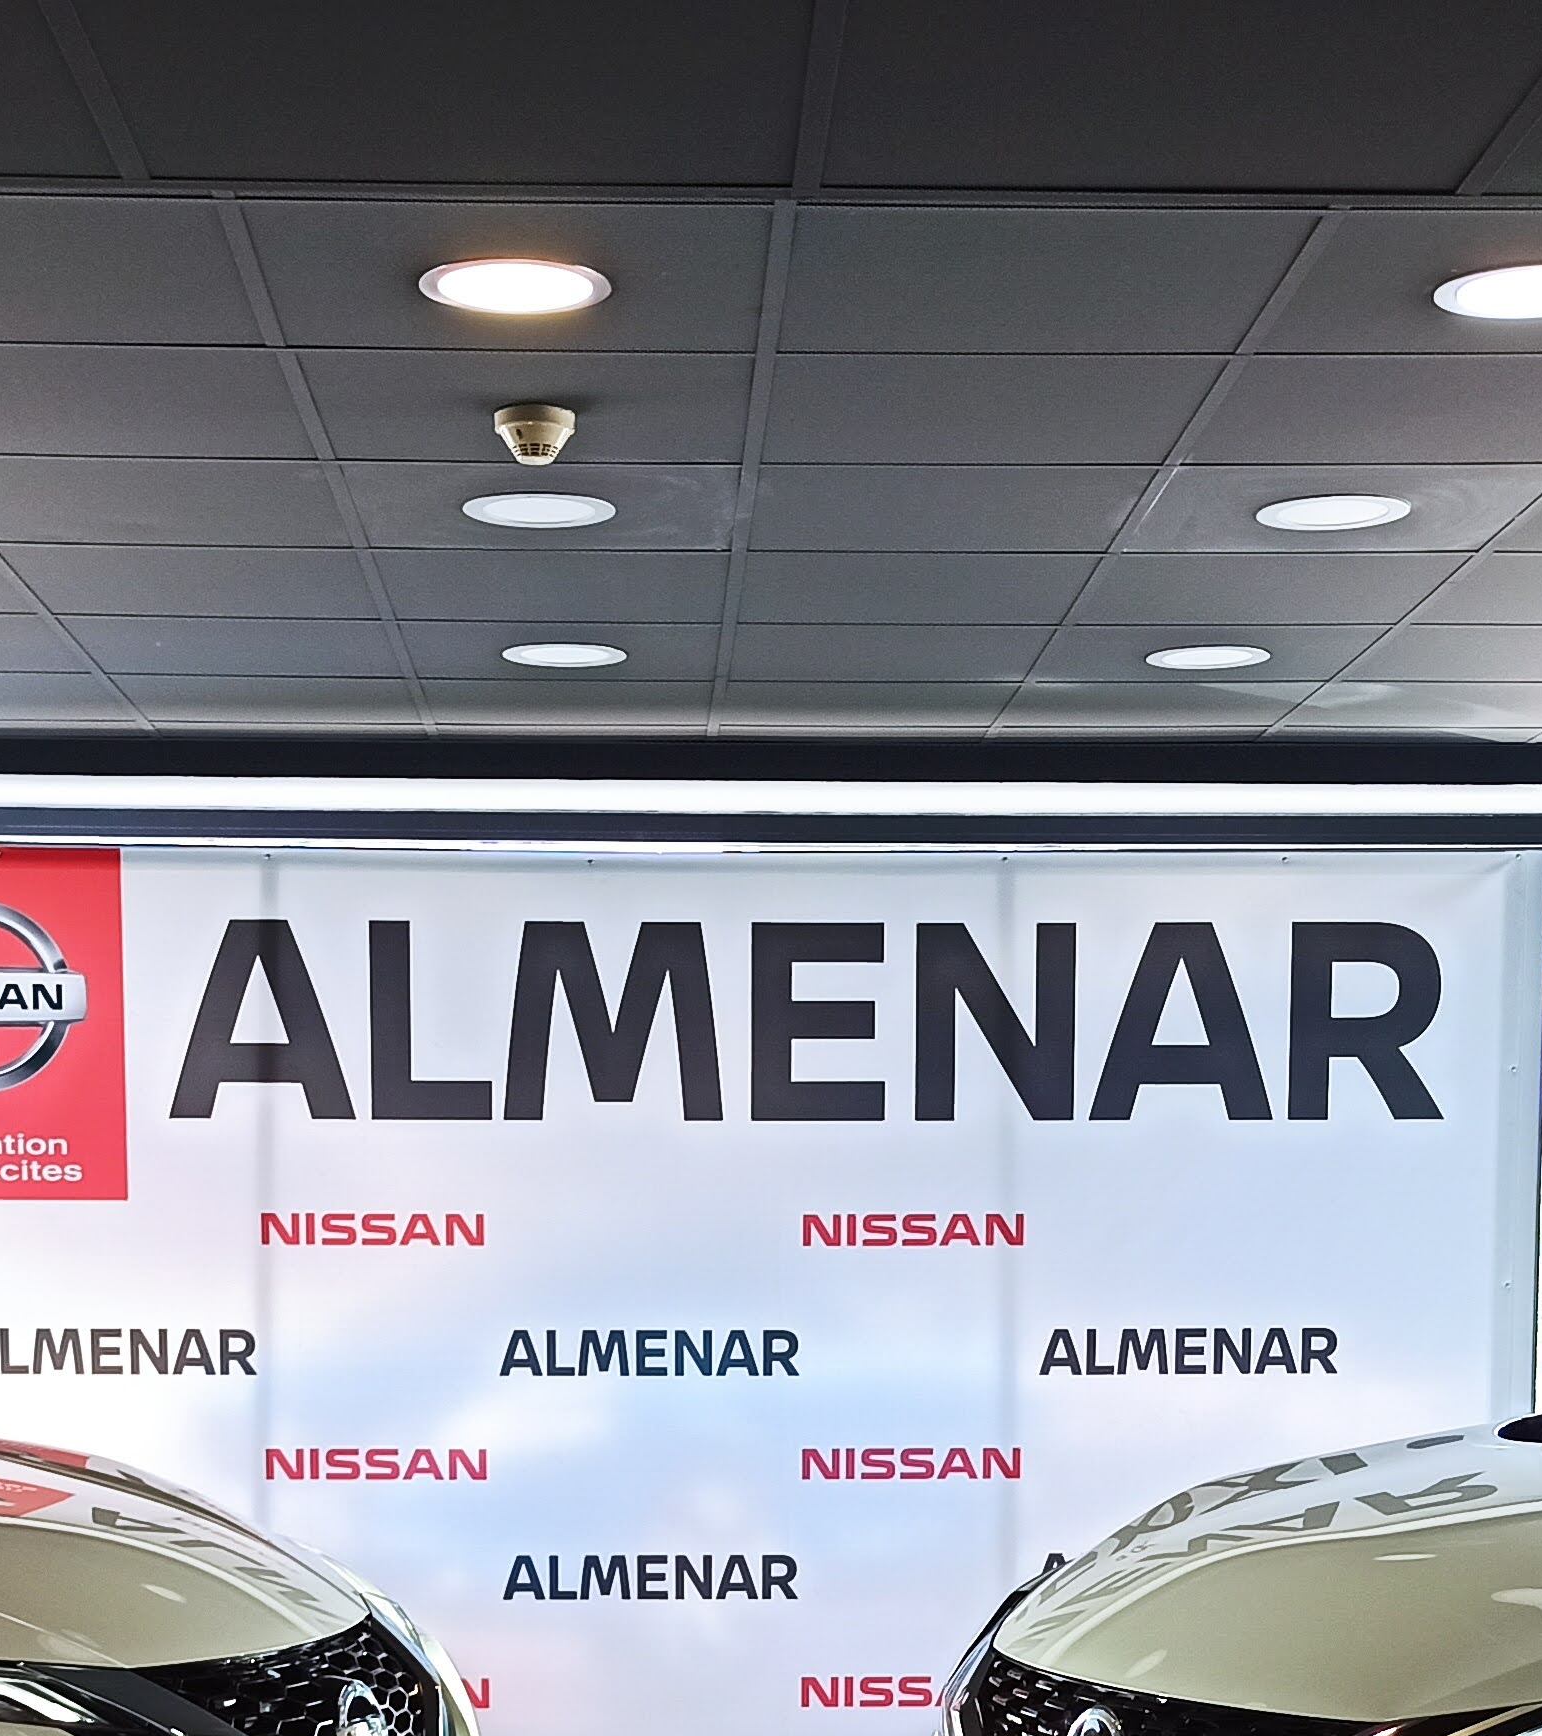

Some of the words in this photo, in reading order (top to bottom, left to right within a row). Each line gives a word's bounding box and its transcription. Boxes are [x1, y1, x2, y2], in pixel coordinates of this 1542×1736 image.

[169, 919, 1444, 1122] ALMENAR
[260, 1213, 486, 1247] NISSAN
[802, 1214, 1025, 1247] NISSAN
[499, 1329, 800, 1377] ALMENAR
[1038, 1327, 1338, 1376] ALMENAR
[265, 1448, 488, 1481] NISSAN
[801, 1447, 1022, 1481] NISSAN
[502, 1554, 799, 1601] ALMENAR
